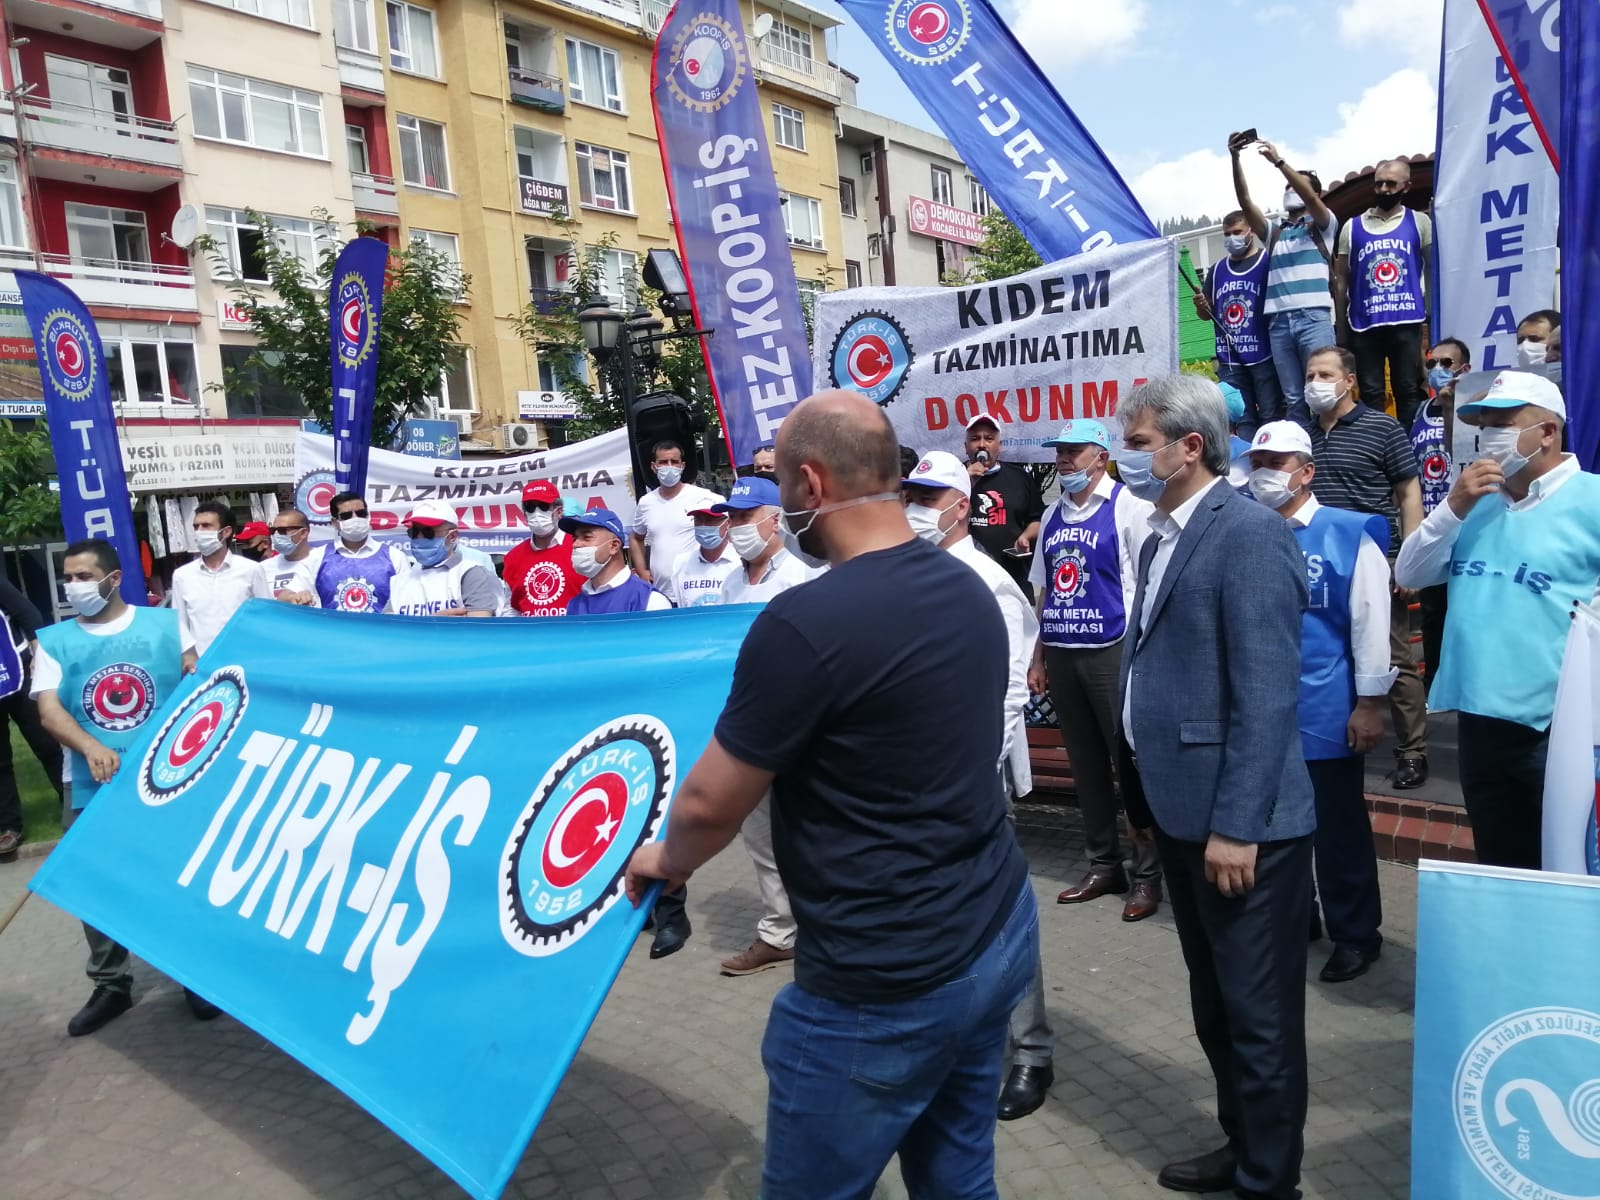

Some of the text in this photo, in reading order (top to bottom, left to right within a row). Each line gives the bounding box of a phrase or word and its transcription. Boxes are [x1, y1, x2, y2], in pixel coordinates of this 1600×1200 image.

[700, 87, 721, 100] 1962
[526, 181, 562, 200] ÇİĞDEM
[930, 203, 976, 230] DEMOKRAT
[1358, 238, 1411, 262] GÖREVLİ
[1480, 182, 1530, 371] METAL
[956, 269, 1111, 329] KIDEM
[1387, 292, 1415, 302] METAL
[932, 326, 1145, 375] TAZMİNATIMA
[7, 405, 45, 414] TURLARI
[924, 377, 1149, 431] DOKUNM
[126, 442, 167, 461] YEŞİL
[173, 443, 222, 458] BURSA
[179, 459, 224, 472] PAZARI
[434, 456, 546, 479] KIDEM
[1045, 527, 1100, 553] GÖREVLİ
[683, 579, 723, 590] BELEDİY
[1063, 608, 1104, 620] METAL
[1043, 621, 1104, 634] SENDİKASI
[90, 665, 121, 688] METAL
[562, 747, 648, 807] TÜRK-İŞ
[178, 702, 491, 1046] TÜRK-İŞ
[528, 879, 583, 916] 1952
